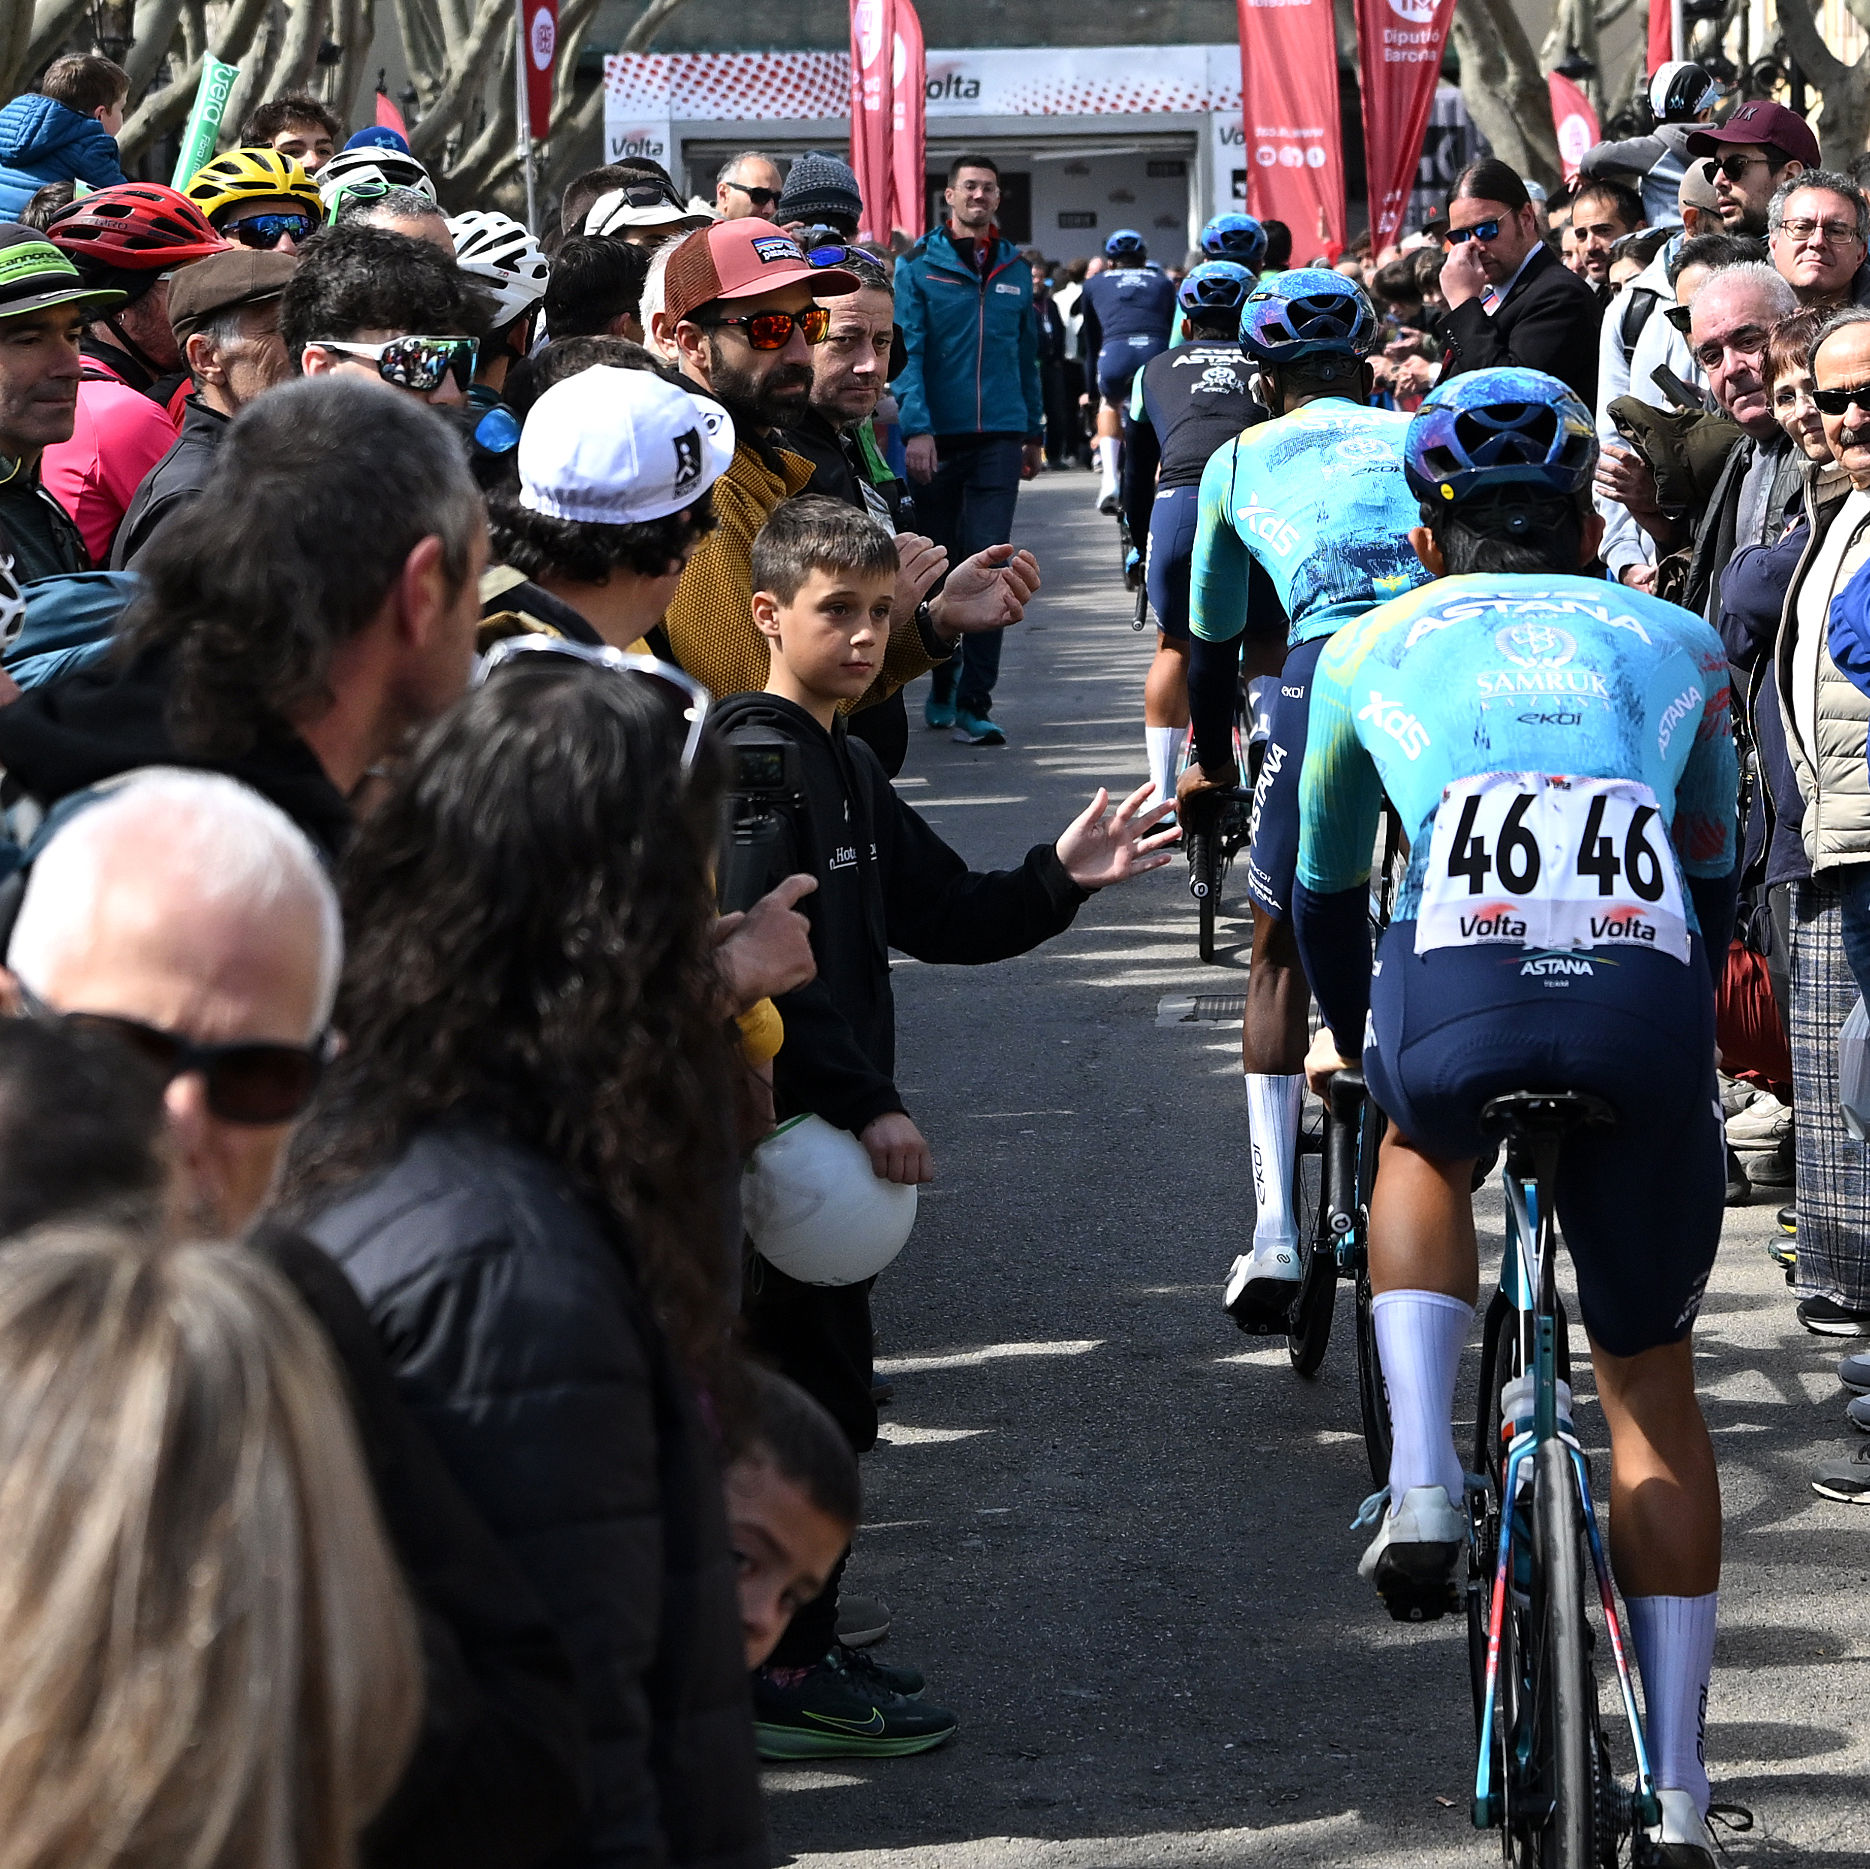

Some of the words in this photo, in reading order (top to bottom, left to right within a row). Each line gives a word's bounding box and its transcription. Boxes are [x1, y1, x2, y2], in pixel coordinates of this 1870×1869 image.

[611, 136, 664, 159] Volta
[1404, 599, 1653, 649] ASTANA
[1476, 672, 1609, 697] SAMRUK
[1657, 685, 1703, 762] ASTANA
[1447, 793, 1541, 896] 46
[1576, 794, 1665, 903] 46
[1459, 914, 1528, 938] Volta
[1589, 916, 1657, 942] Volta
[1519, 958, 1595, 976] ASTANA
